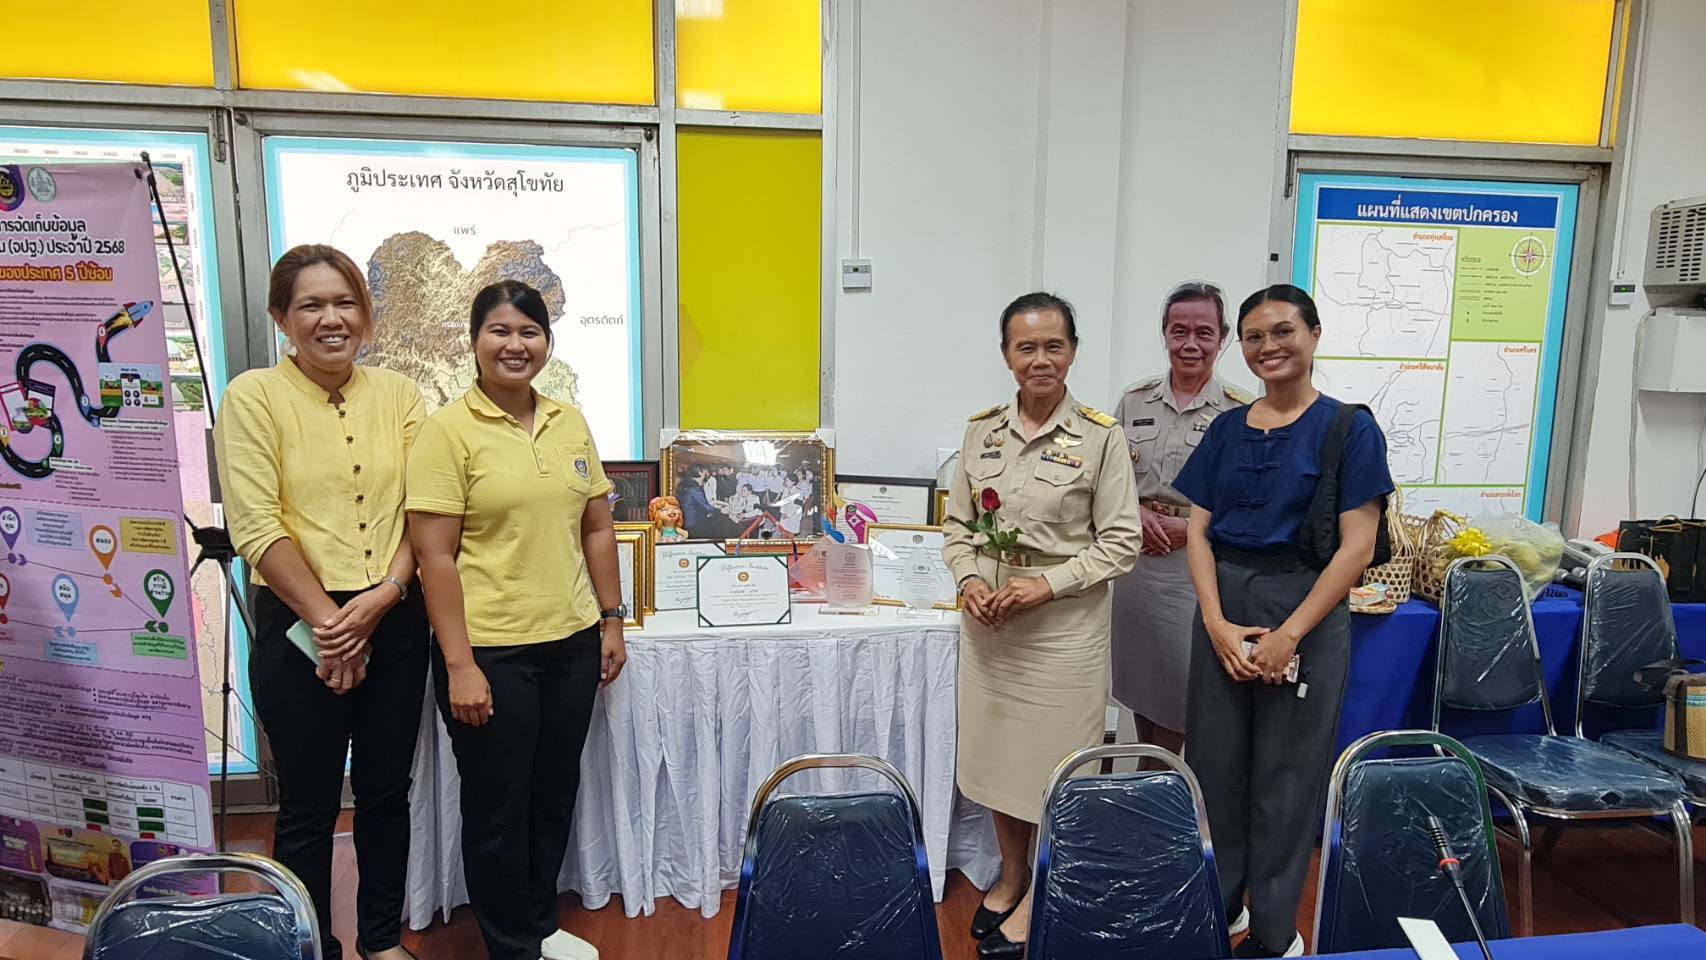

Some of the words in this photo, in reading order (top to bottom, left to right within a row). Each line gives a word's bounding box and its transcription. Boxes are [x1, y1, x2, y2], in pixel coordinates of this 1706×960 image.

[347, 167, 443, 193] ภูมิประเทศ
[448, 169, 564, 197] จังหวัดสุโขทัย
[1357, 195, 1519, 223] แผนที่แสดงเขตปกครอง
[0, 214, 86, 240] ารจัดเก็บข้อมูล
[8, 239, 44, 257] (จปฐ.)
[47, 236, 92, 254] ประจำปี
[95, 240, 125, 254] 2568
[65, 264, 76, 281] 5
[579, 315, 624, 325] อุตรดิตถ์
